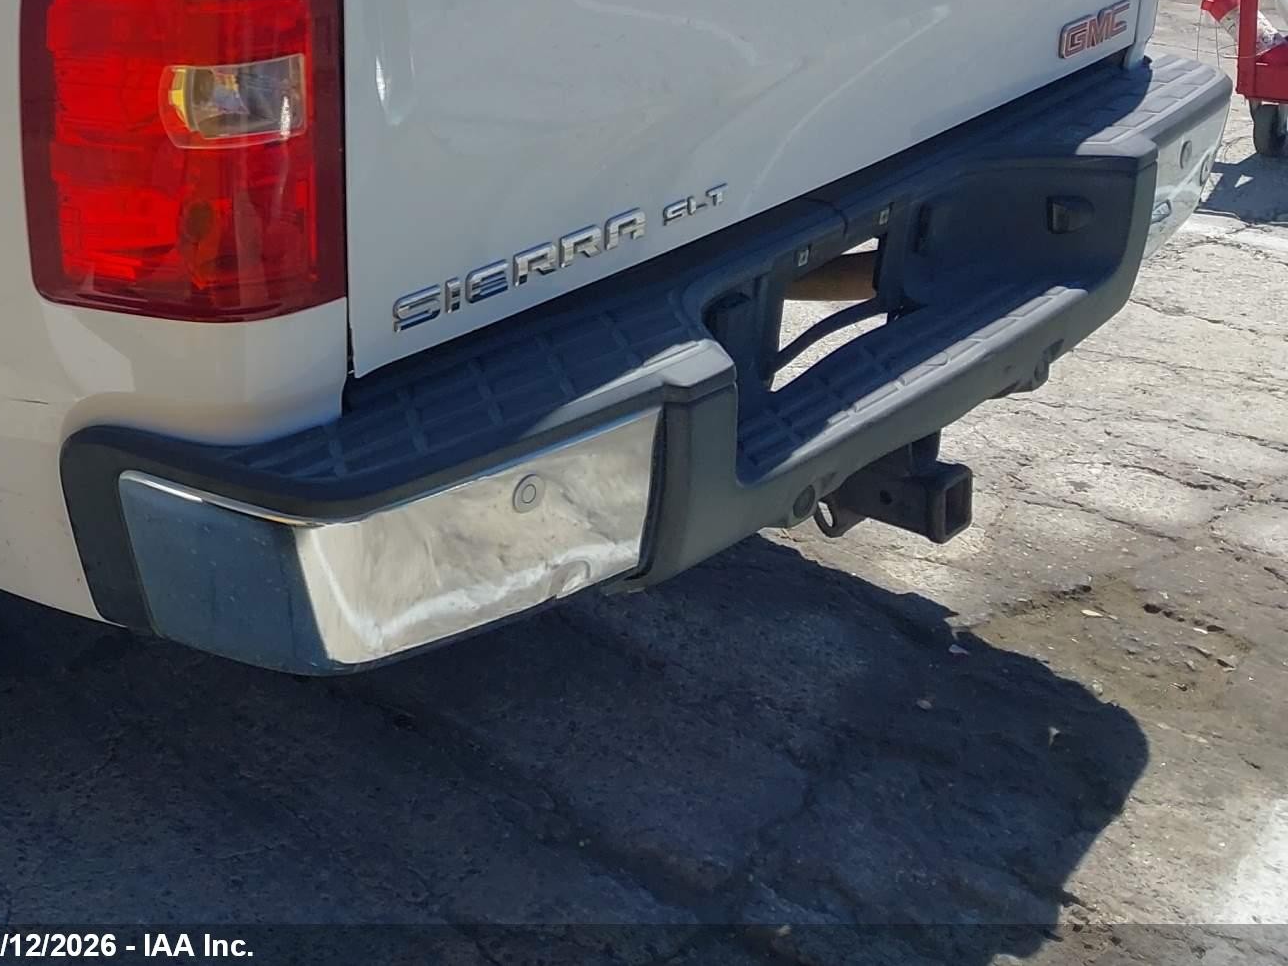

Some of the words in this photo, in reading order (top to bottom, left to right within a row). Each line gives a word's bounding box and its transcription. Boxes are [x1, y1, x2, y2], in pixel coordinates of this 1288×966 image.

[1058, 0, 1130, 60] GMC
[392, 207, 647, 332] SIERRA
[661, 182, 728, 227] SLT
